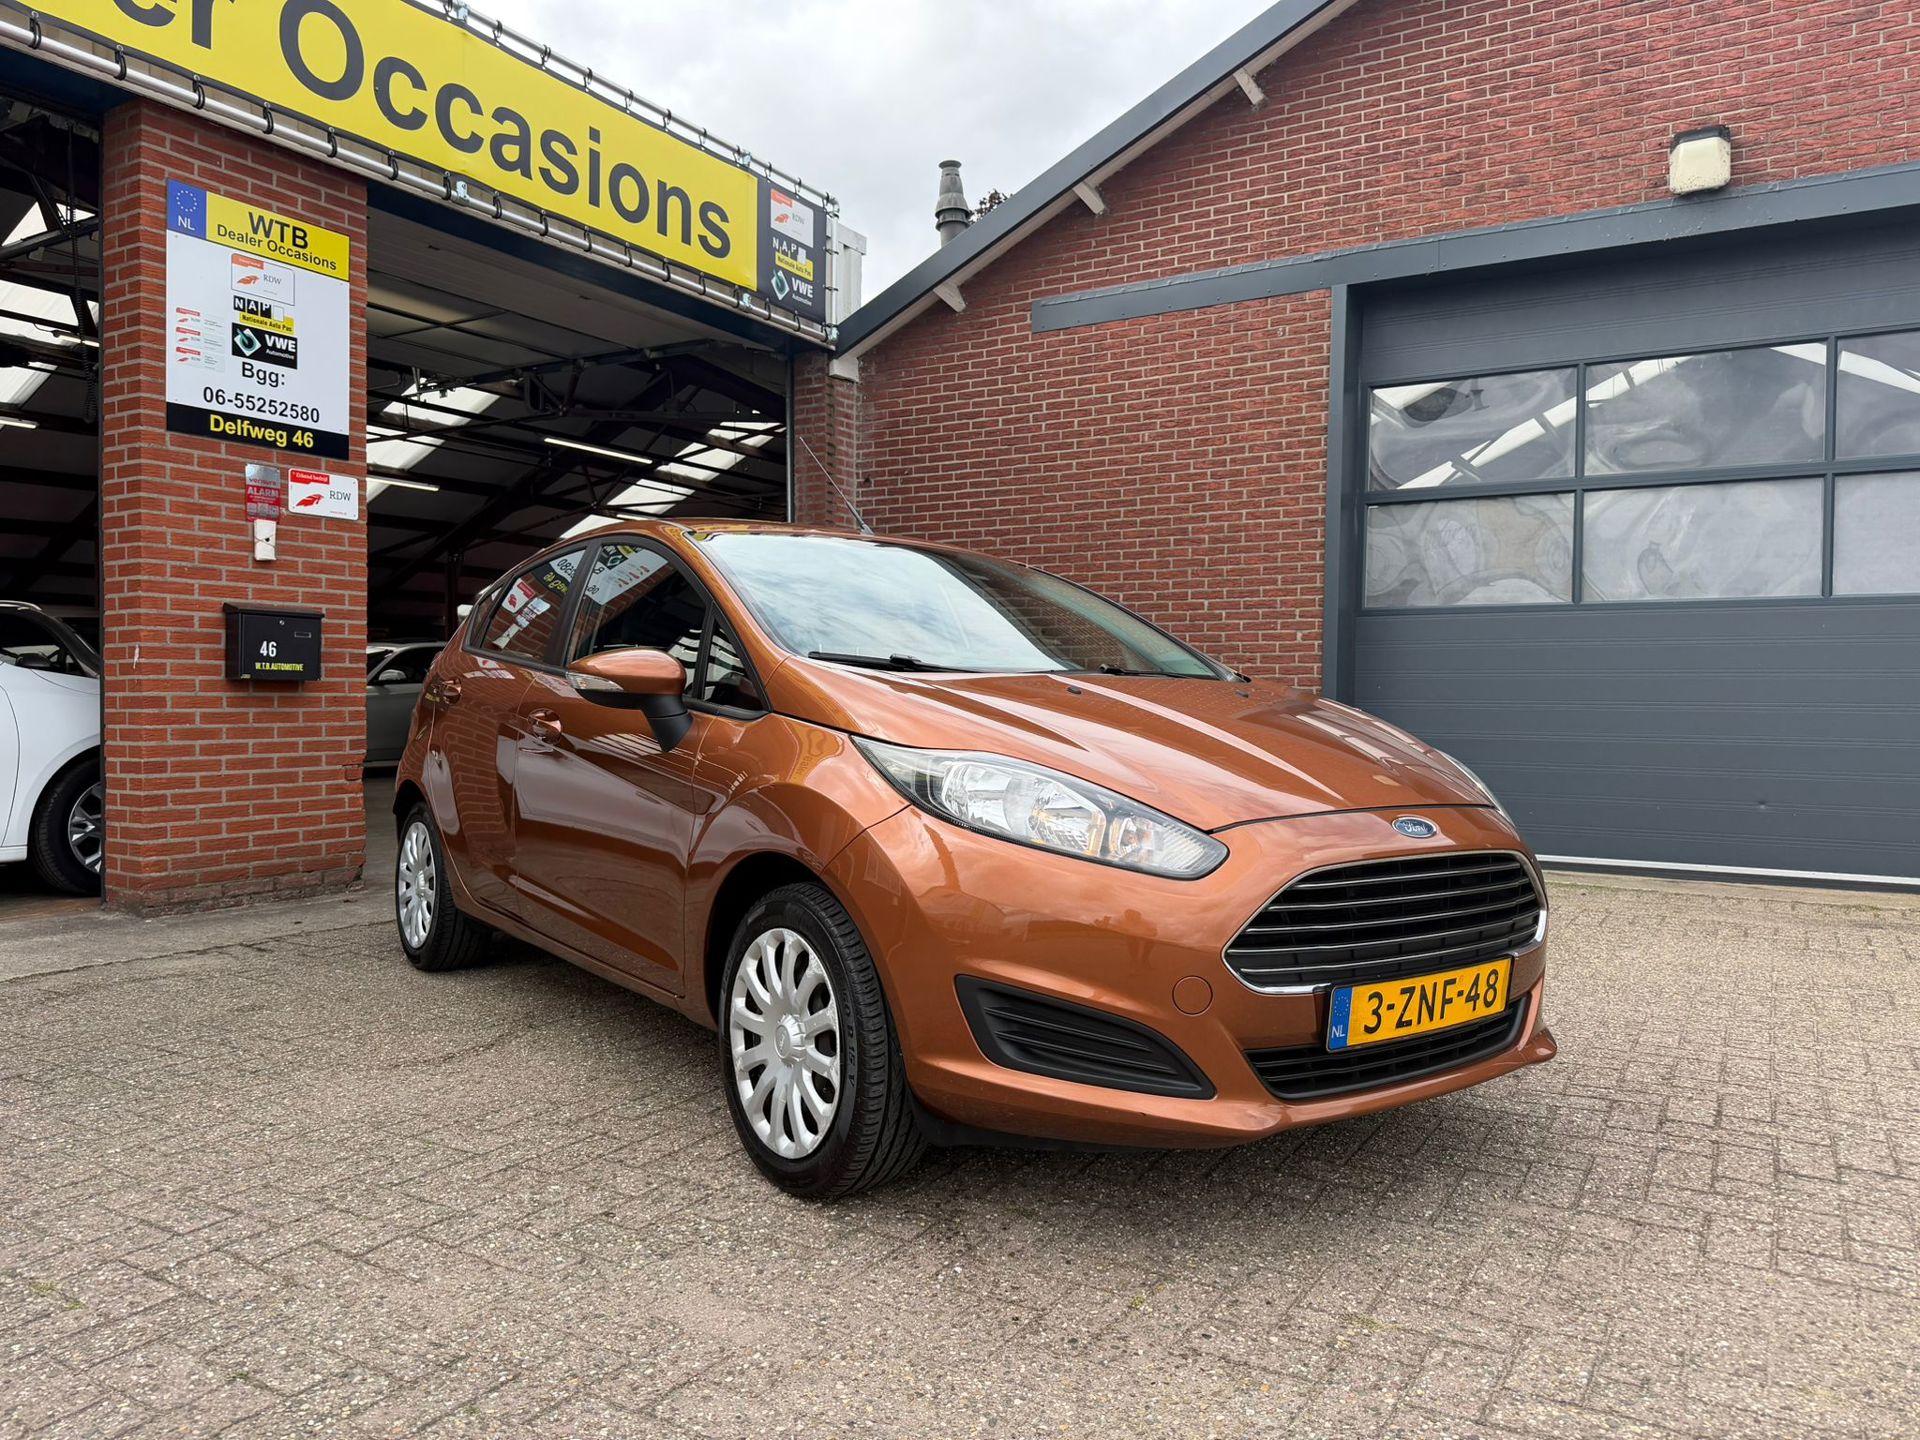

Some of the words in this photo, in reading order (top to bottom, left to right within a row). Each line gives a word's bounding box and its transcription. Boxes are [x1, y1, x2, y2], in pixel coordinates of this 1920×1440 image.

[279, 0, 731, 258] Occasions
[177, 215, 196, 231] NL
[248, 211, 309, 250] WTB
[217, 224, 263, 248] Dealer
[267, 240, 337, 271] Occasions
[263, 274, 282, 285] RDW
[791, 277, 813, 298] VWE
[242, 314, 268, 326] Nationale
[268, 320, 281, 330] Auto
[264, 334, 297, 352] VWE
[266, 348, 295, 360] Automotive
[242, 361, 285, 388] Bgg:
[203, 386, 320, 424] 06-55252580
[209, 414, 287, 448] Delfweg
[292, 430, 314, 448] 46
[247, 486, 279, 498] ALARM
[329, 490, 352, 501] RDW
[260, 640, 277, 657] 46
[1363, 968, 1499, 1035] 3-ZNF-48
[1331, 1024, 1346, 1038] NL
